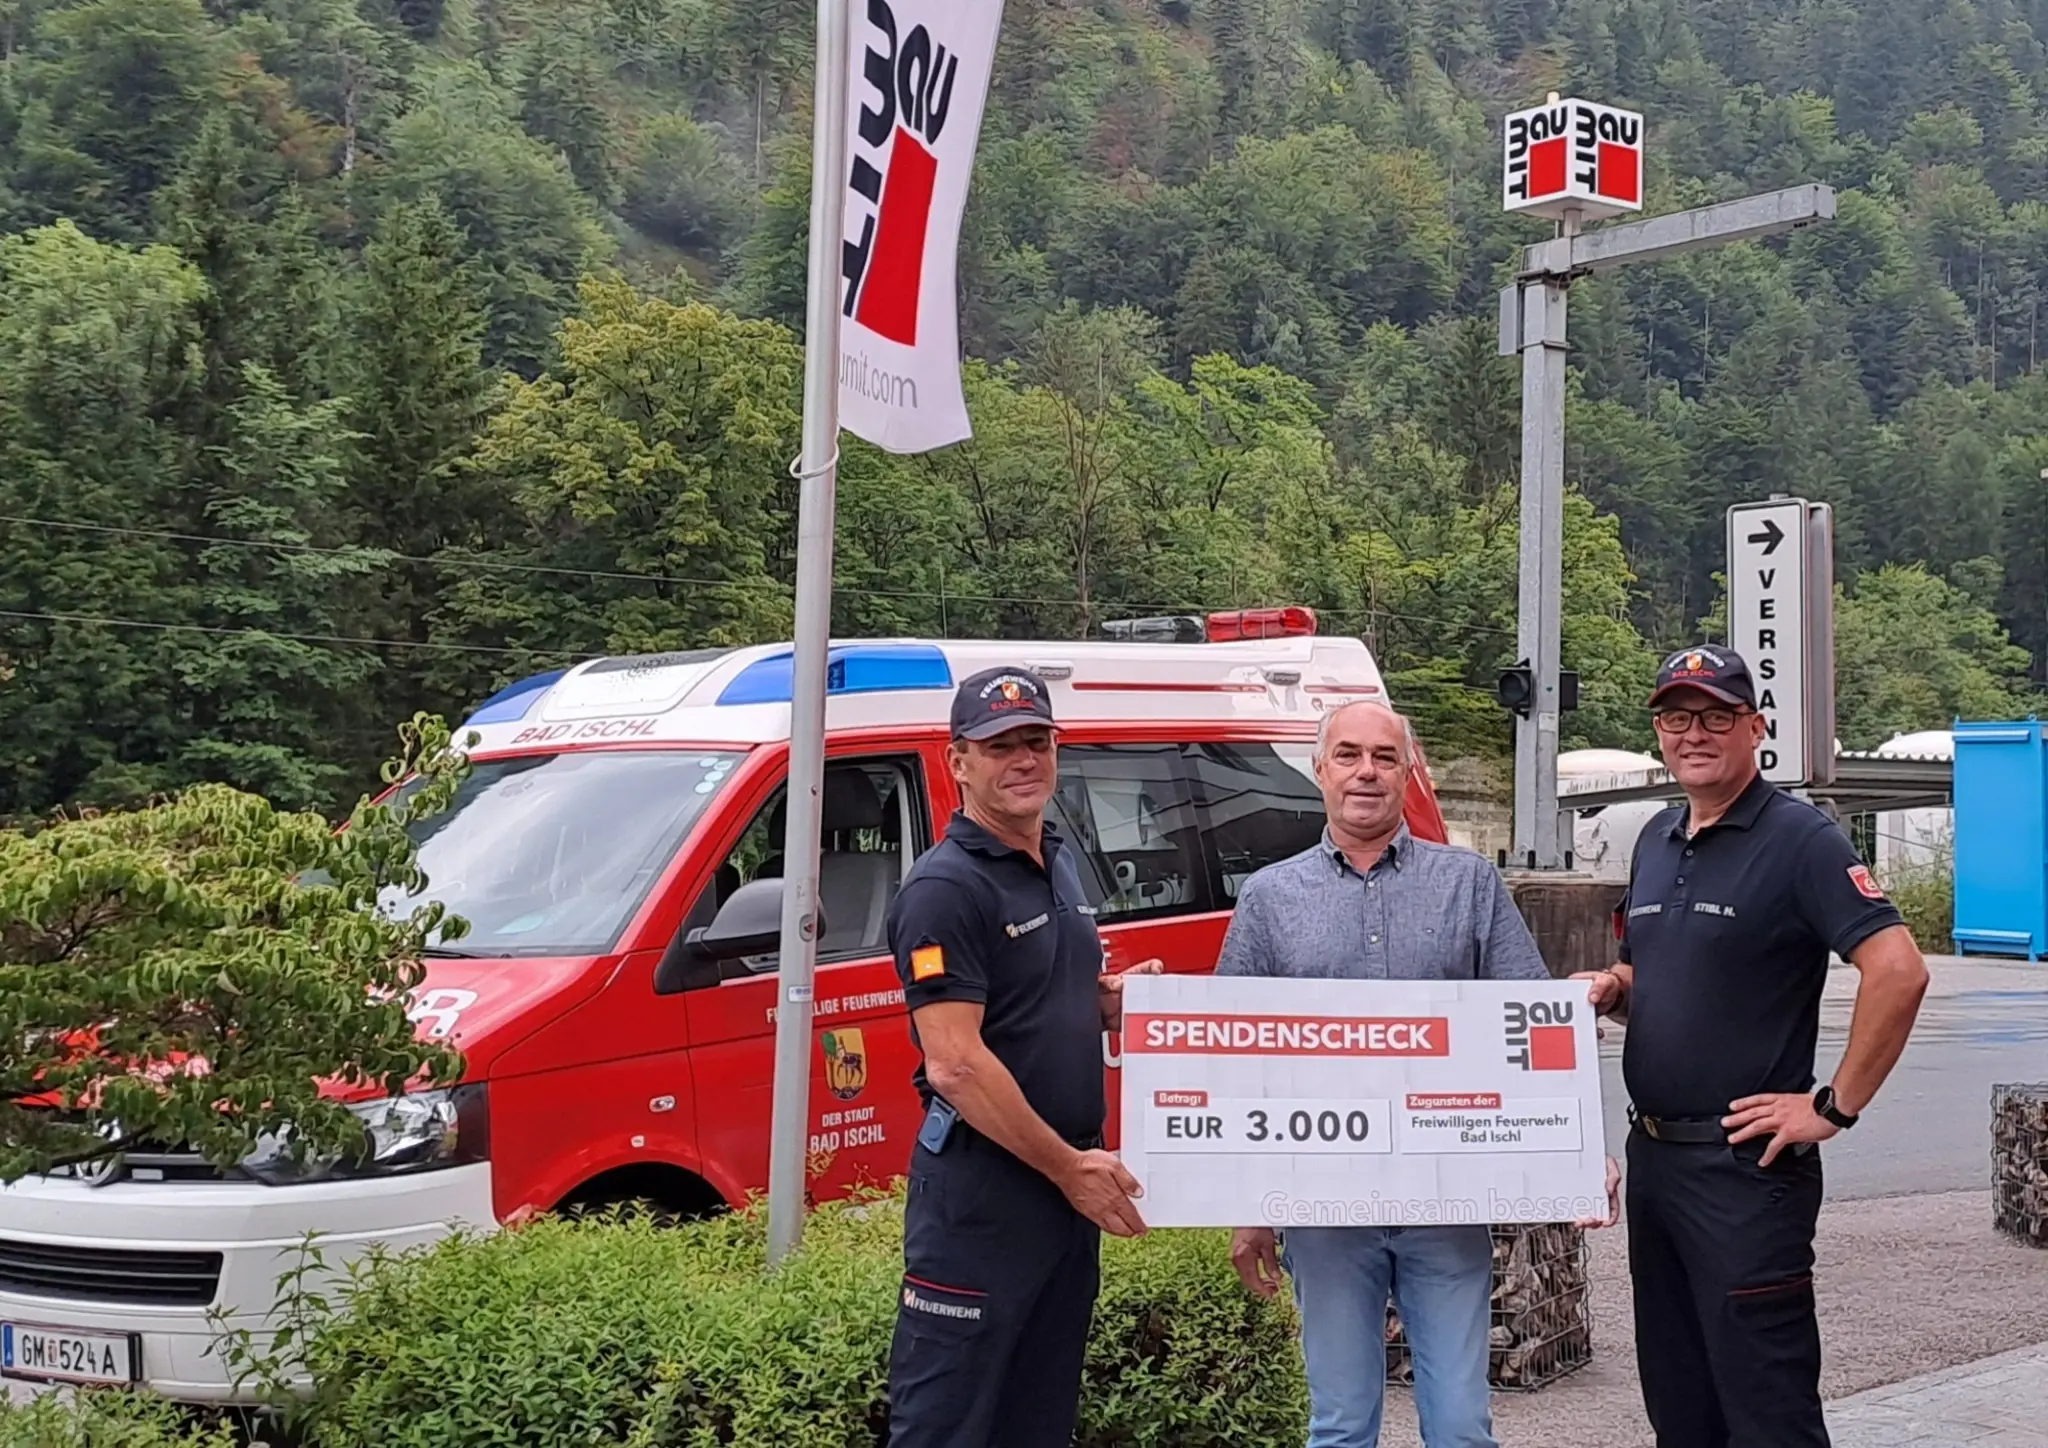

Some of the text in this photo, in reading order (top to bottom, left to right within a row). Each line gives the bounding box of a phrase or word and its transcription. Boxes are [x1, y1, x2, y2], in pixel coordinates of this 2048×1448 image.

[1758, 567, 1778, 771] VERSAND
[511, 719, 659, 744] BAD ISCHL
[842, 988, 906, 1013] FEUERWEH
[1144, 1018, 1434, 1051] SPENDENSCHECK
[1410, 1095, 1472, 1109] Zugunsten
[821, 1106, 876, 1128] DER STADT
[1166, 1109, 1370, 1143] EUR 3.000
[1411, 1113, 1570, 1131] Freiwilligen Feuerwehr
[810, 1123, 886, 1153] BAD ISCHL
[1460, 1130, 1522, 1143] Bad Ischl
[1261, 1187, 1606, 1225] Gemeinsam besser
[914, 1296, 981, 1320] FEUERWEHR
